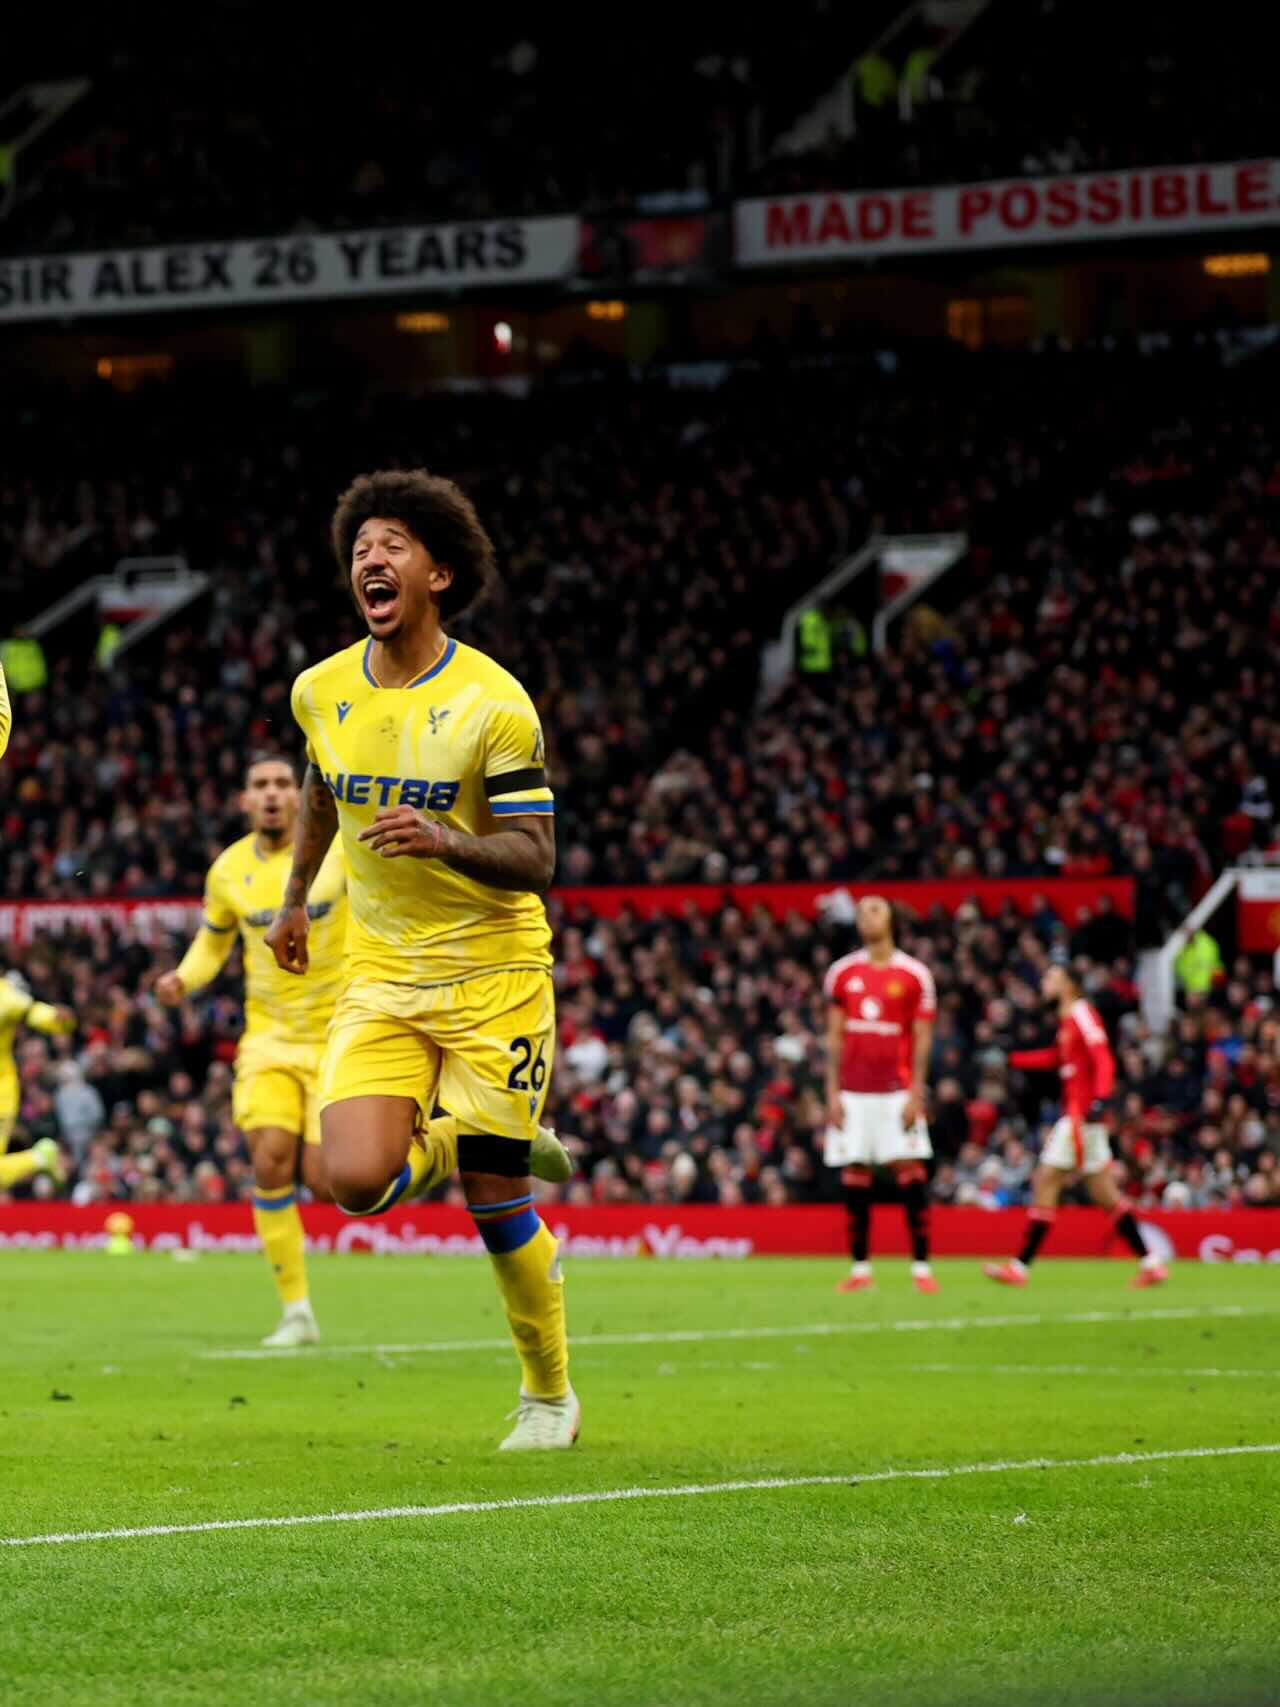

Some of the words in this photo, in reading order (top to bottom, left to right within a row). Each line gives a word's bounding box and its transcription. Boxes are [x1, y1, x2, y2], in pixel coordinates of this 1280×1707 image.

[765, 192, 937, 246] MADE
[92, 250, 233, 298] ALEX
[252, 236, 319, 286] 26
[334, 226, 528, 280] YEARS
[508, 1037, 546, 1092] 26
